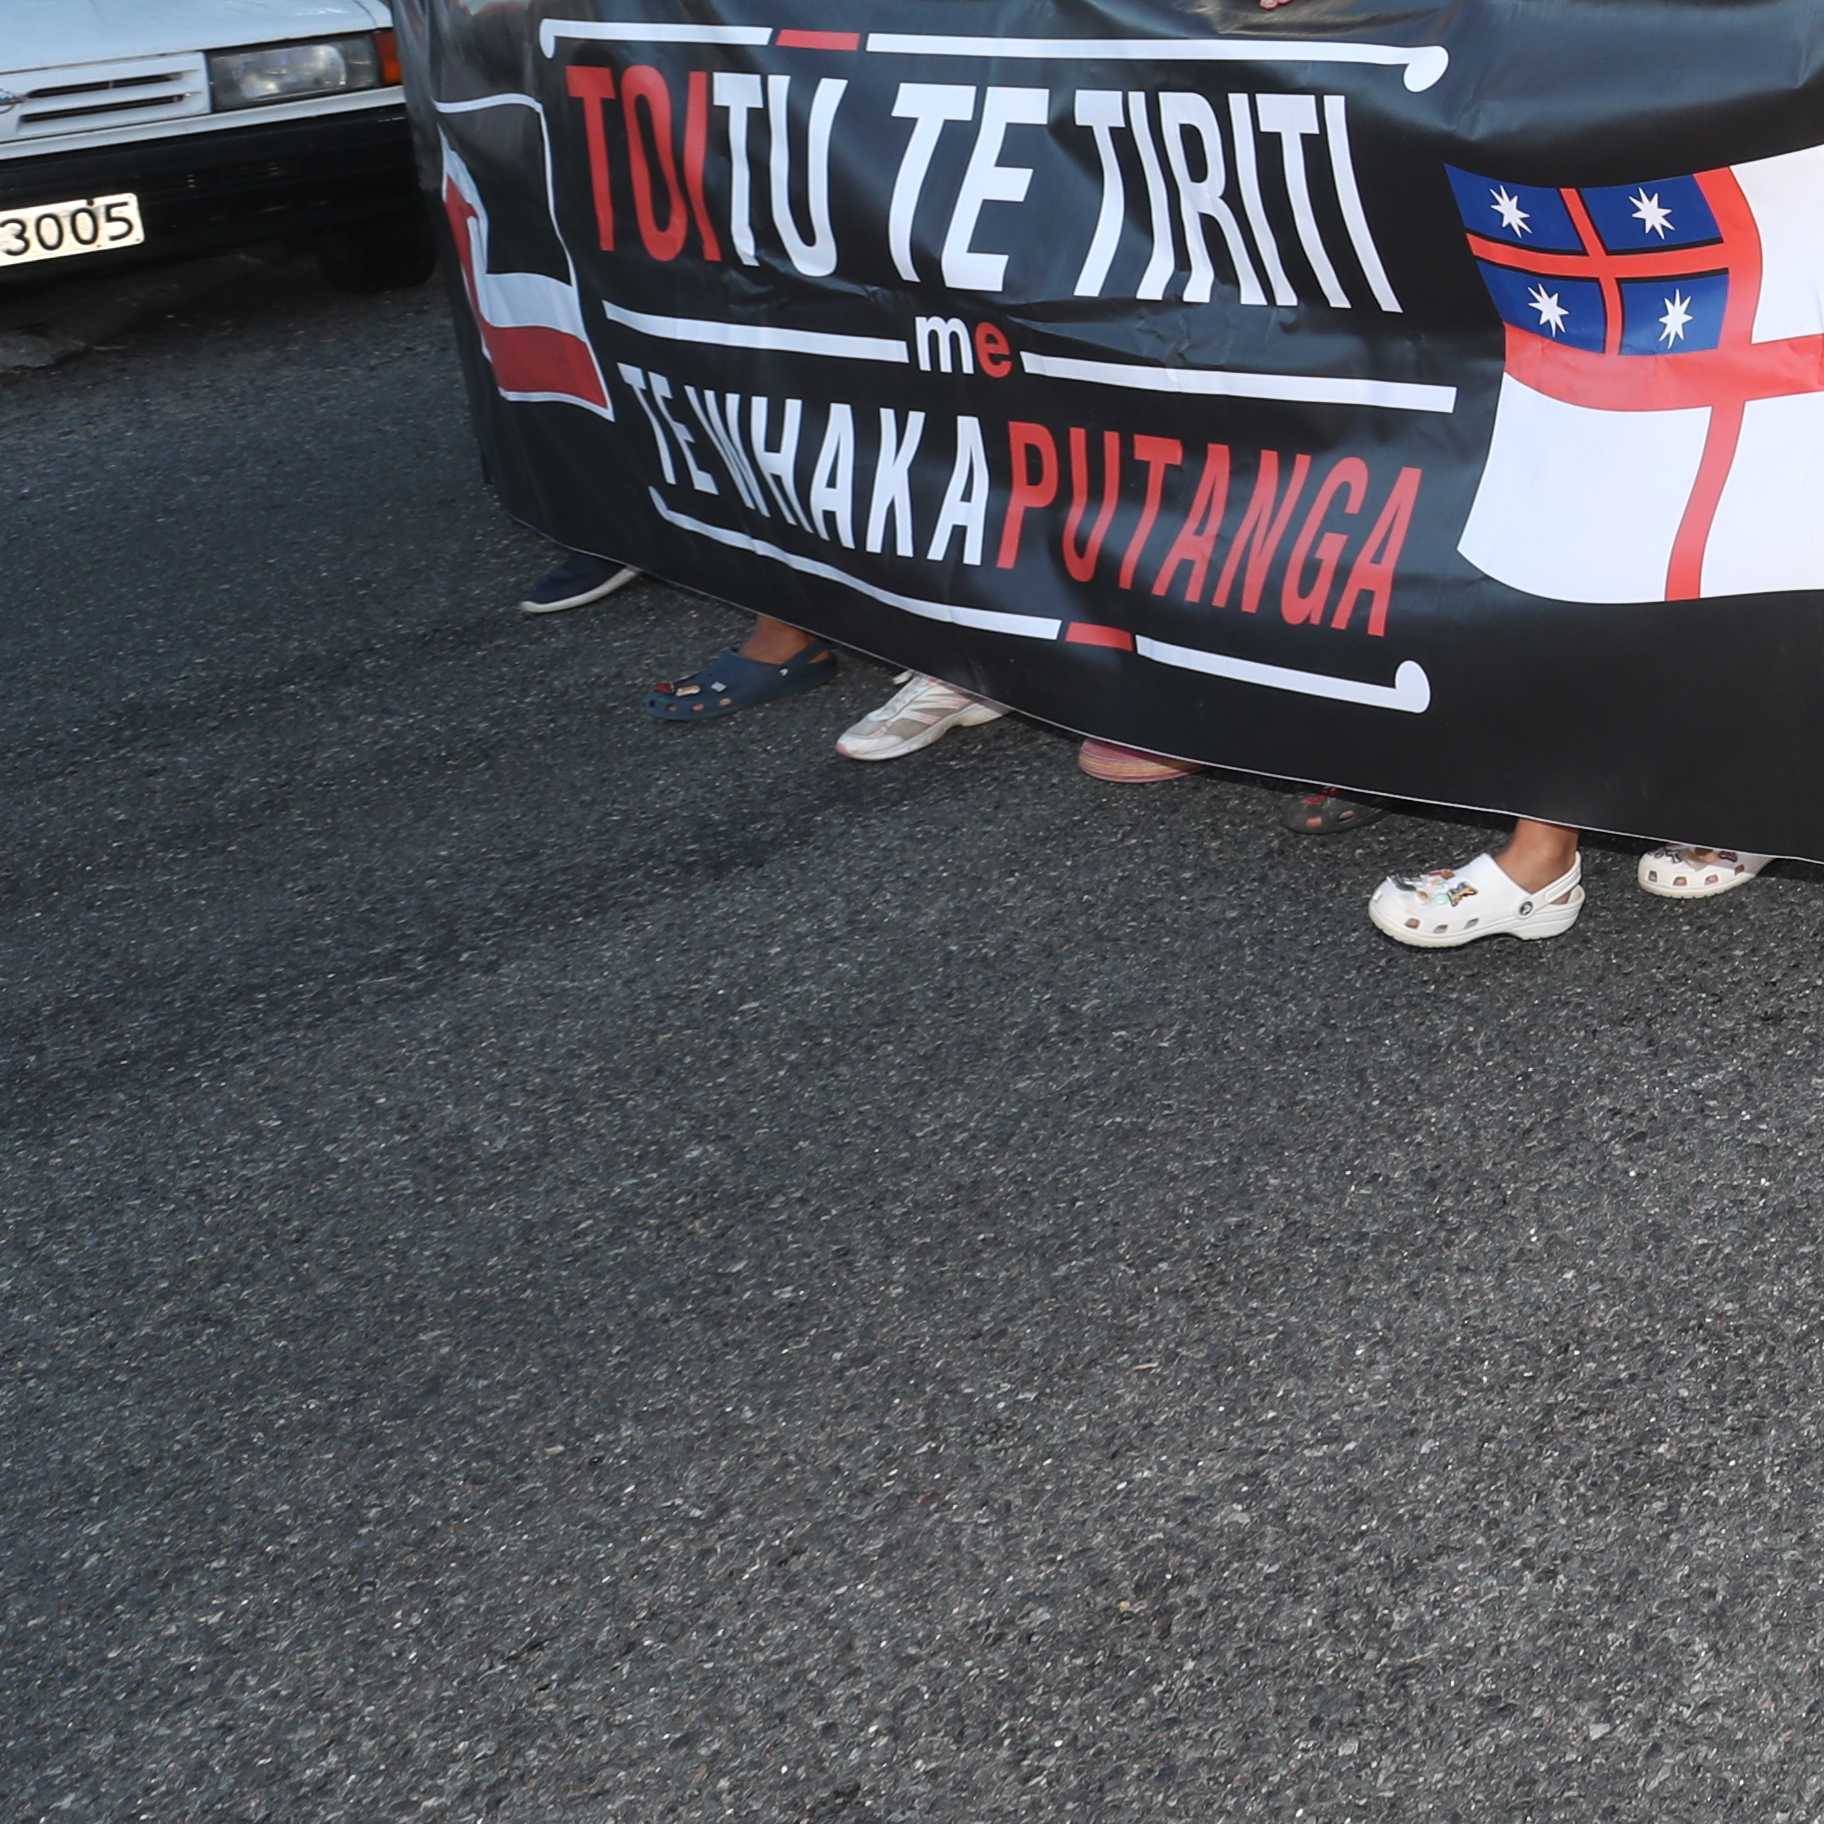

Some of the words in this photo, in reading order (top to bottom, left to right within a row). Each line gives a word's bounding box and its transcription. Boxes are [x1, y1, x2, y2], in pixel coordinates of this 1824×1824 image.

[889, 82, 1050, 291] TE
[1074, 89, 1403, 313] TIRITI
[915, 314, 1013, 379] me
[617, 362, 717, 494] TE
